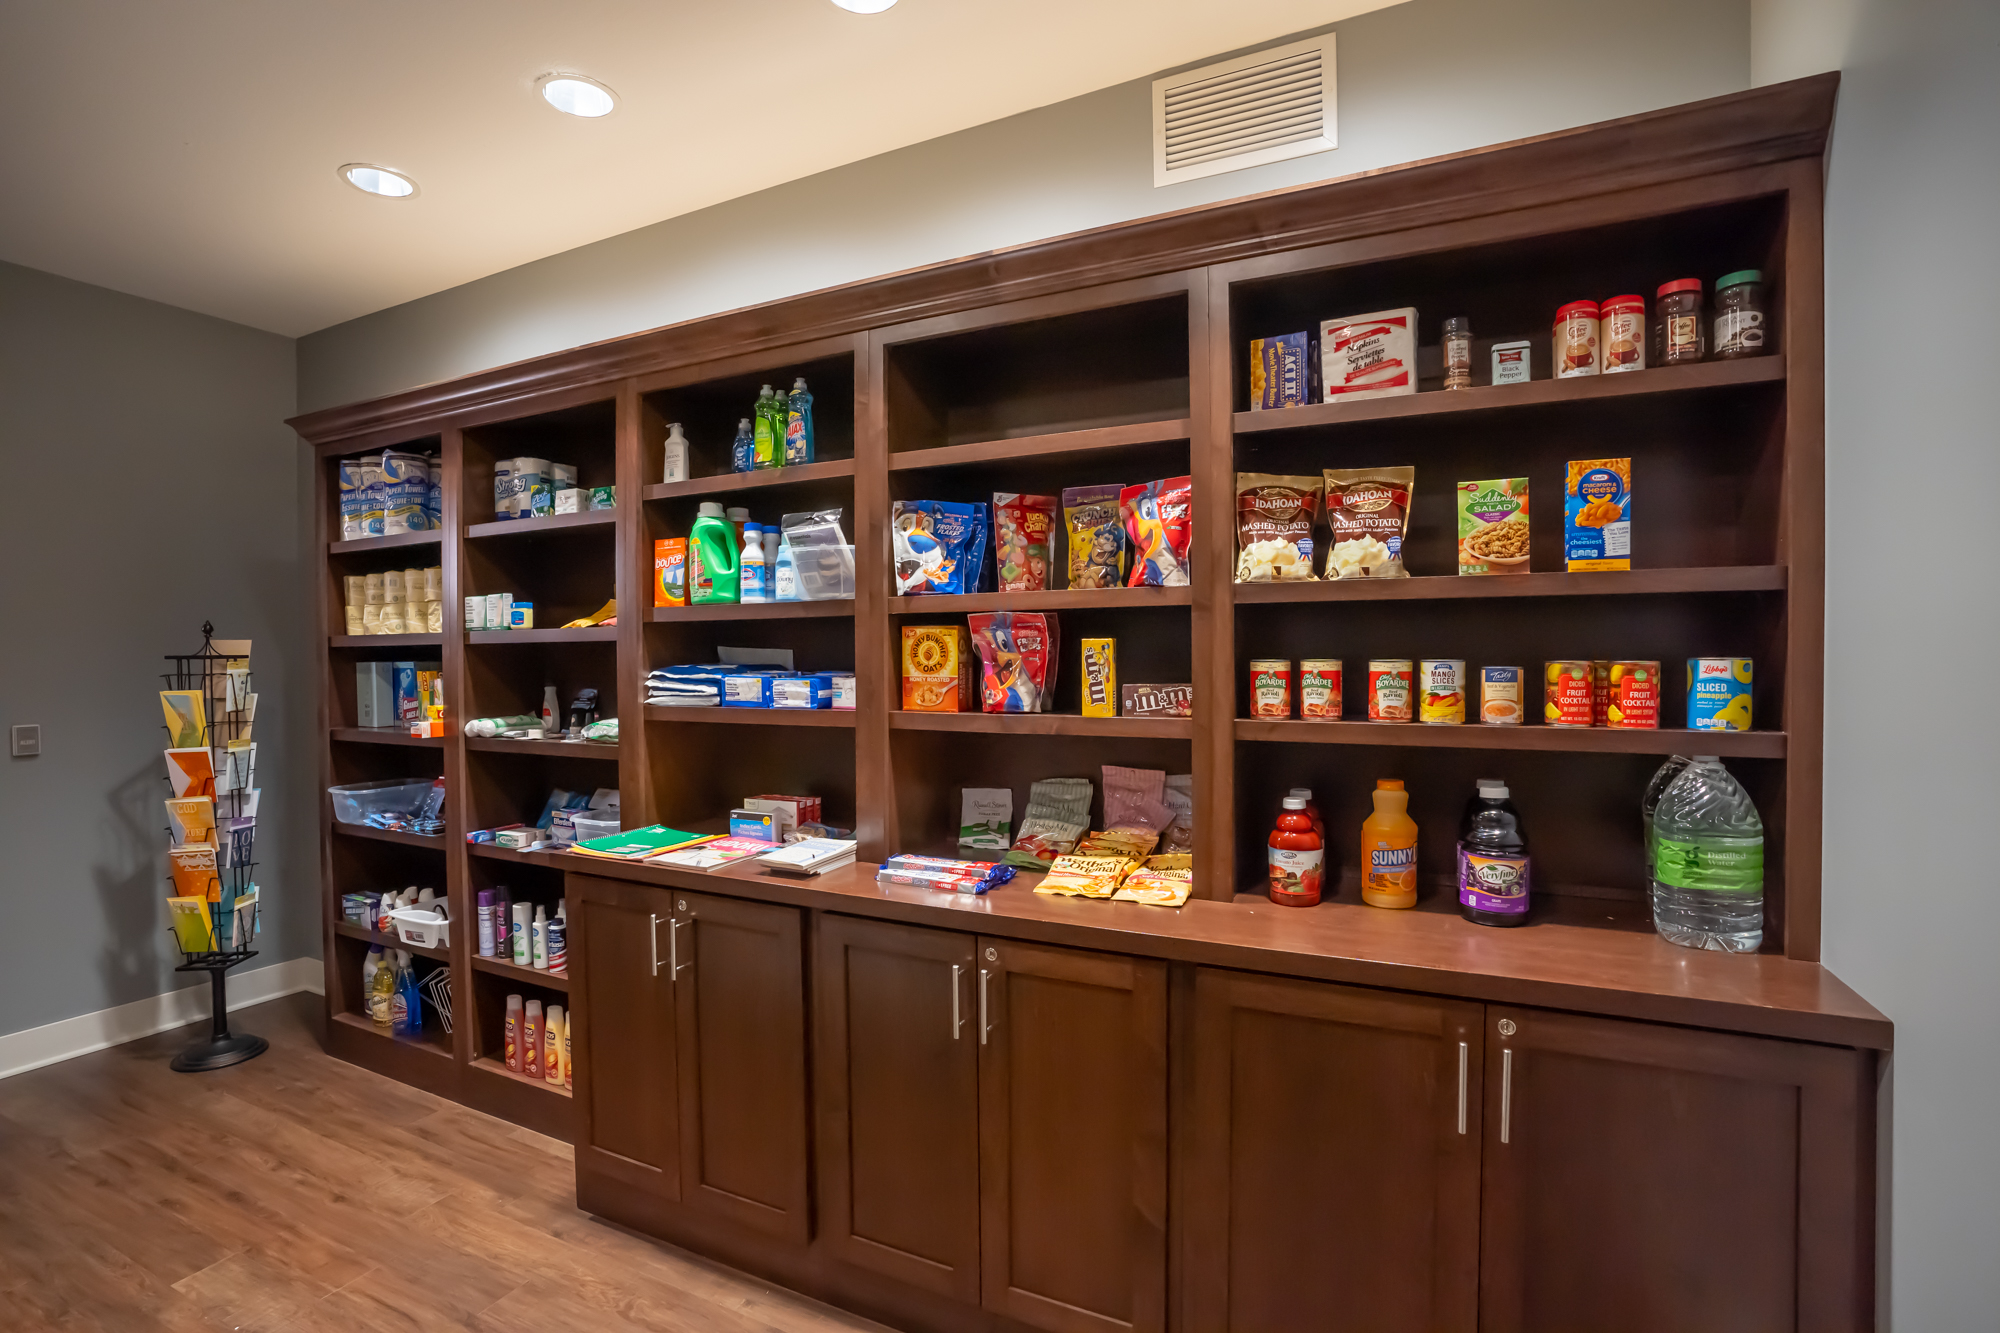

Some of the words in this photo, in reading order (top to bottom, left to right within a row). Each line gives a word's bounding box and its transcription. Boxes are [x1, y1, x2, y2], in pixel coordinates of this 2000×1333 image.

[1674, 322, 1690, 330] Coffee
[1268, 348, 1276, 365] Movie
[1347, 348, 1385, 365] Serviettes
[1284, 354, 1296, 378] ACT
[1352, 362, 1362, 372] de
[1364, 356, 1384, 368] table
[1500, 372, 1522, 380] Pepper
[1268, 388, 1278, 408] Butter
[788, 421, 803, 437] AJAX
[496, 478, 526, 493] Strong
[593, 493, 608, 502] Spring
[1256, 498, 1302, 508] IDAHOAN
[1342, 490, 1392, 505] IDAHOAN
[1468, 490, 1518, 508] Suddenly
[1474, 504, 1511, 512] SALAD
[1072, 508, 1116, 521] CRUNCH
[936, 524, 964, 532] FROSTED
[1242, 522, 1275, 532] MASHED
[656, 554, 682, 569] bounce
[913, 636, 925, 658] HONEY
[926, 634, 946, 658] BUNCHES
[923, 661, 943, 672] OATS
[1701, 664, 1728, 674] Libby's
[1490, 671, 1512, 682] Tasty
[1256, 679, 1286, 687] BOYARDEE
[1302, 679, 1332, 687] BOYARDEE
[1376, 680, 1409, 688] BOYARDEE
[1697, 683, 1727, 692] SLICED
[1697, 691, 1732, 700] pineapple
[177, 803, 197, 814] GOD
[553, 818, 572, 826] Efferdent
[1061, 857, 1122, 868] Werther's
[1070, 863, 1116, 874] Original
[1481, 870, 1516, 880] Veryfine
